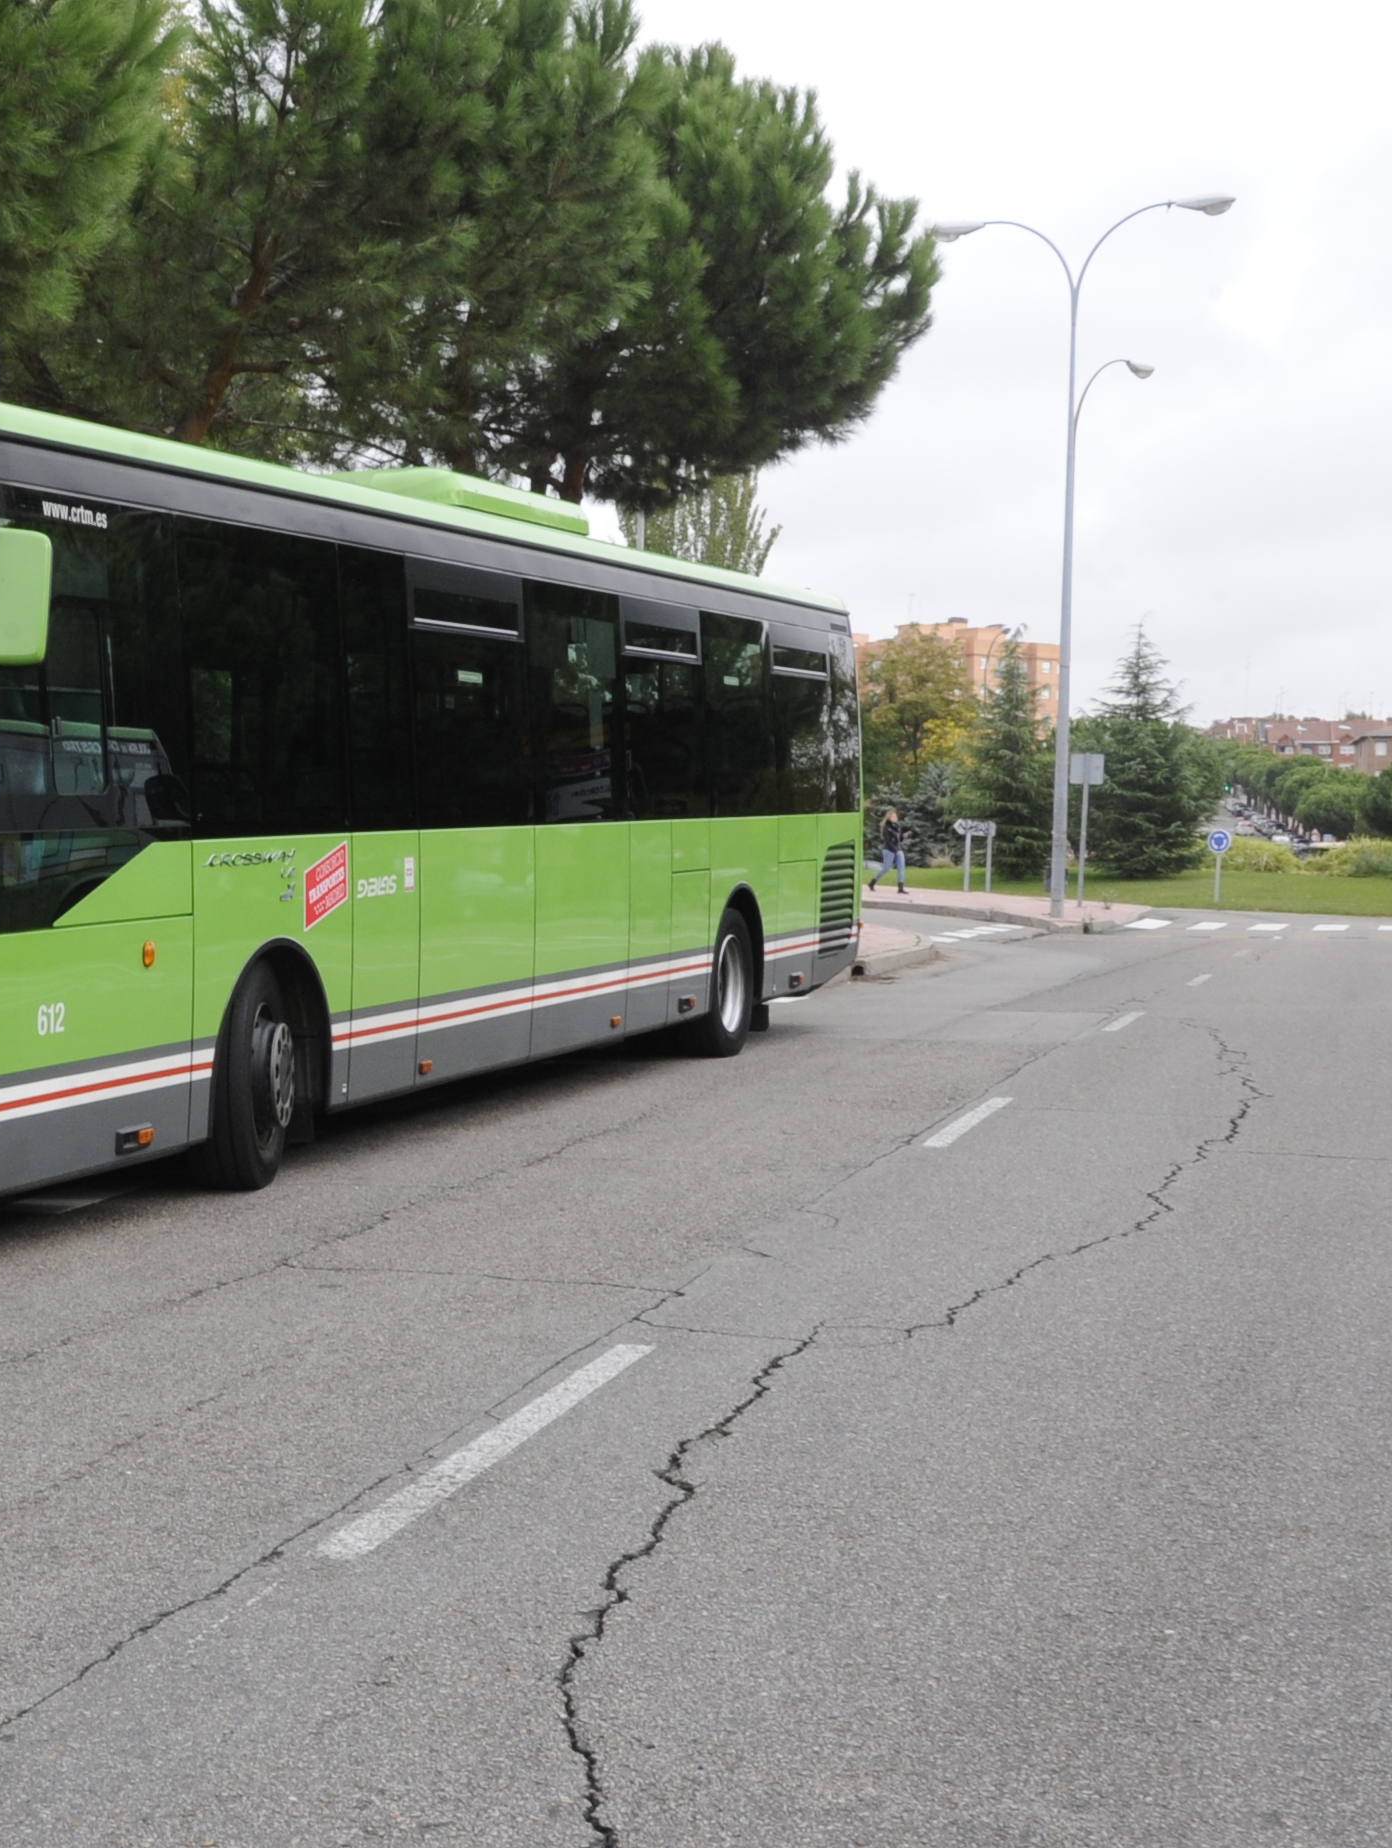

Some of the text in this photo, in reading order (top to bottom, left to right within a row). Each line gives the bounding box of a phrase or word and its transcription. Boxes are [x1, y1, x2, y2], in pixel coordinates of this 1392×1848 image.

[42, 500, 108, 529] www.crtm.es
[308, 866, 345, 905] TRANSPORTES
[37, 1001, 65, 1036] 612
